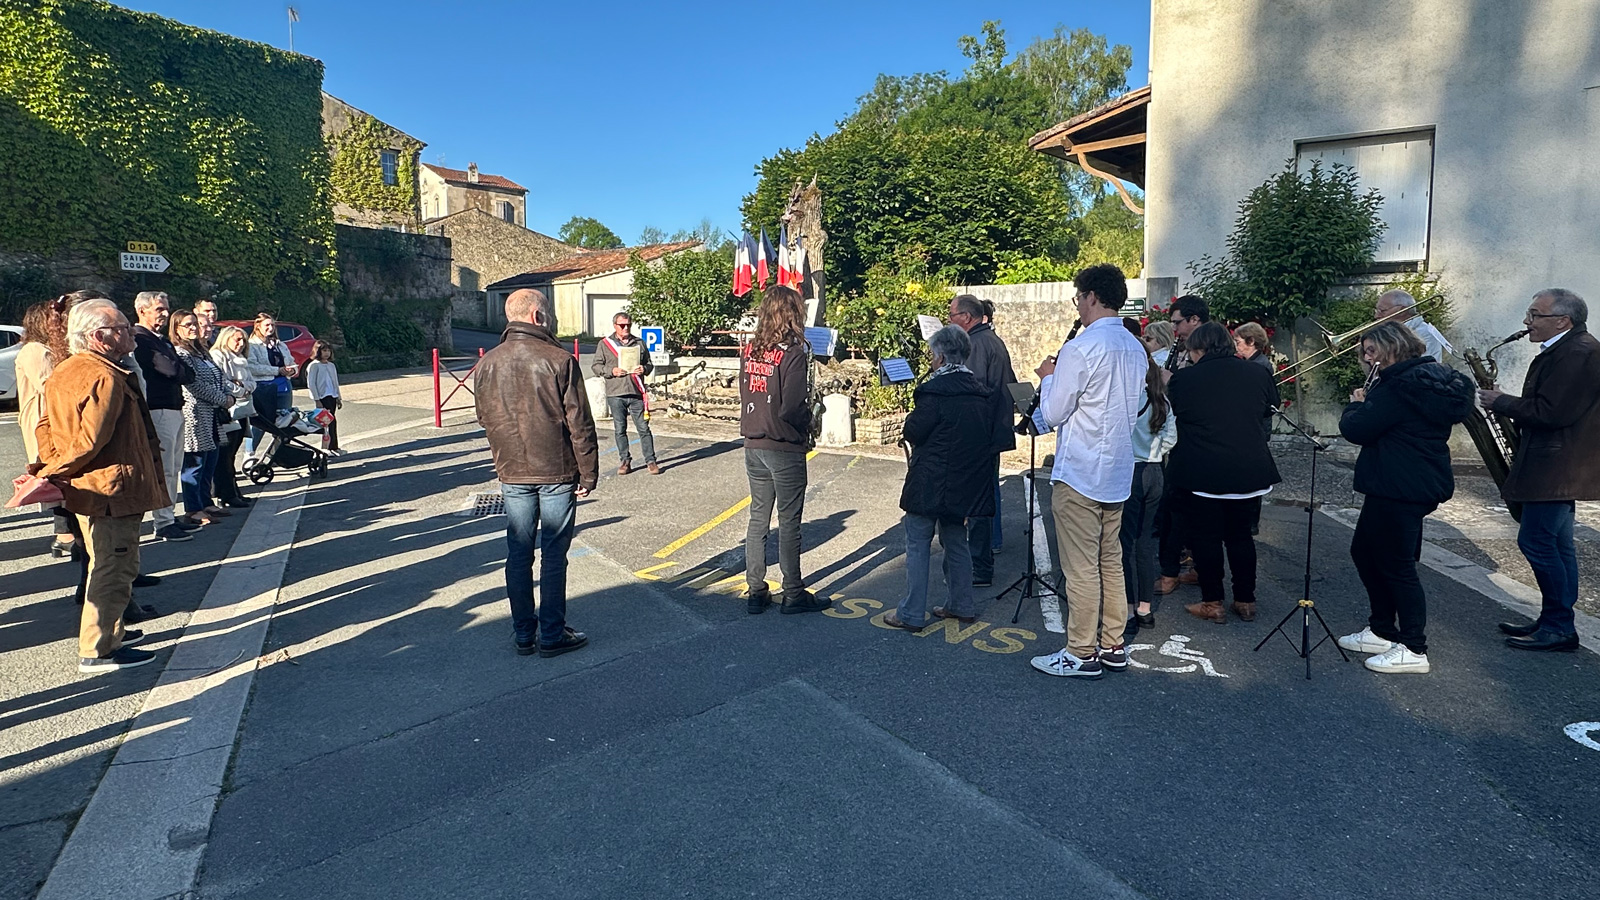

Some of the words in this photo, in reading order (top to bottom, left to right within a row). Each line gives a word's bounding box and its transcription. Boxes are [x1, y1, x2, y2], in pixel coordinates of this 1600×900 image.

[123, 255, 161, 263] SAINTES
[123, 262, 159, 270] COGNAC
[646, 332, 657, 349] P
